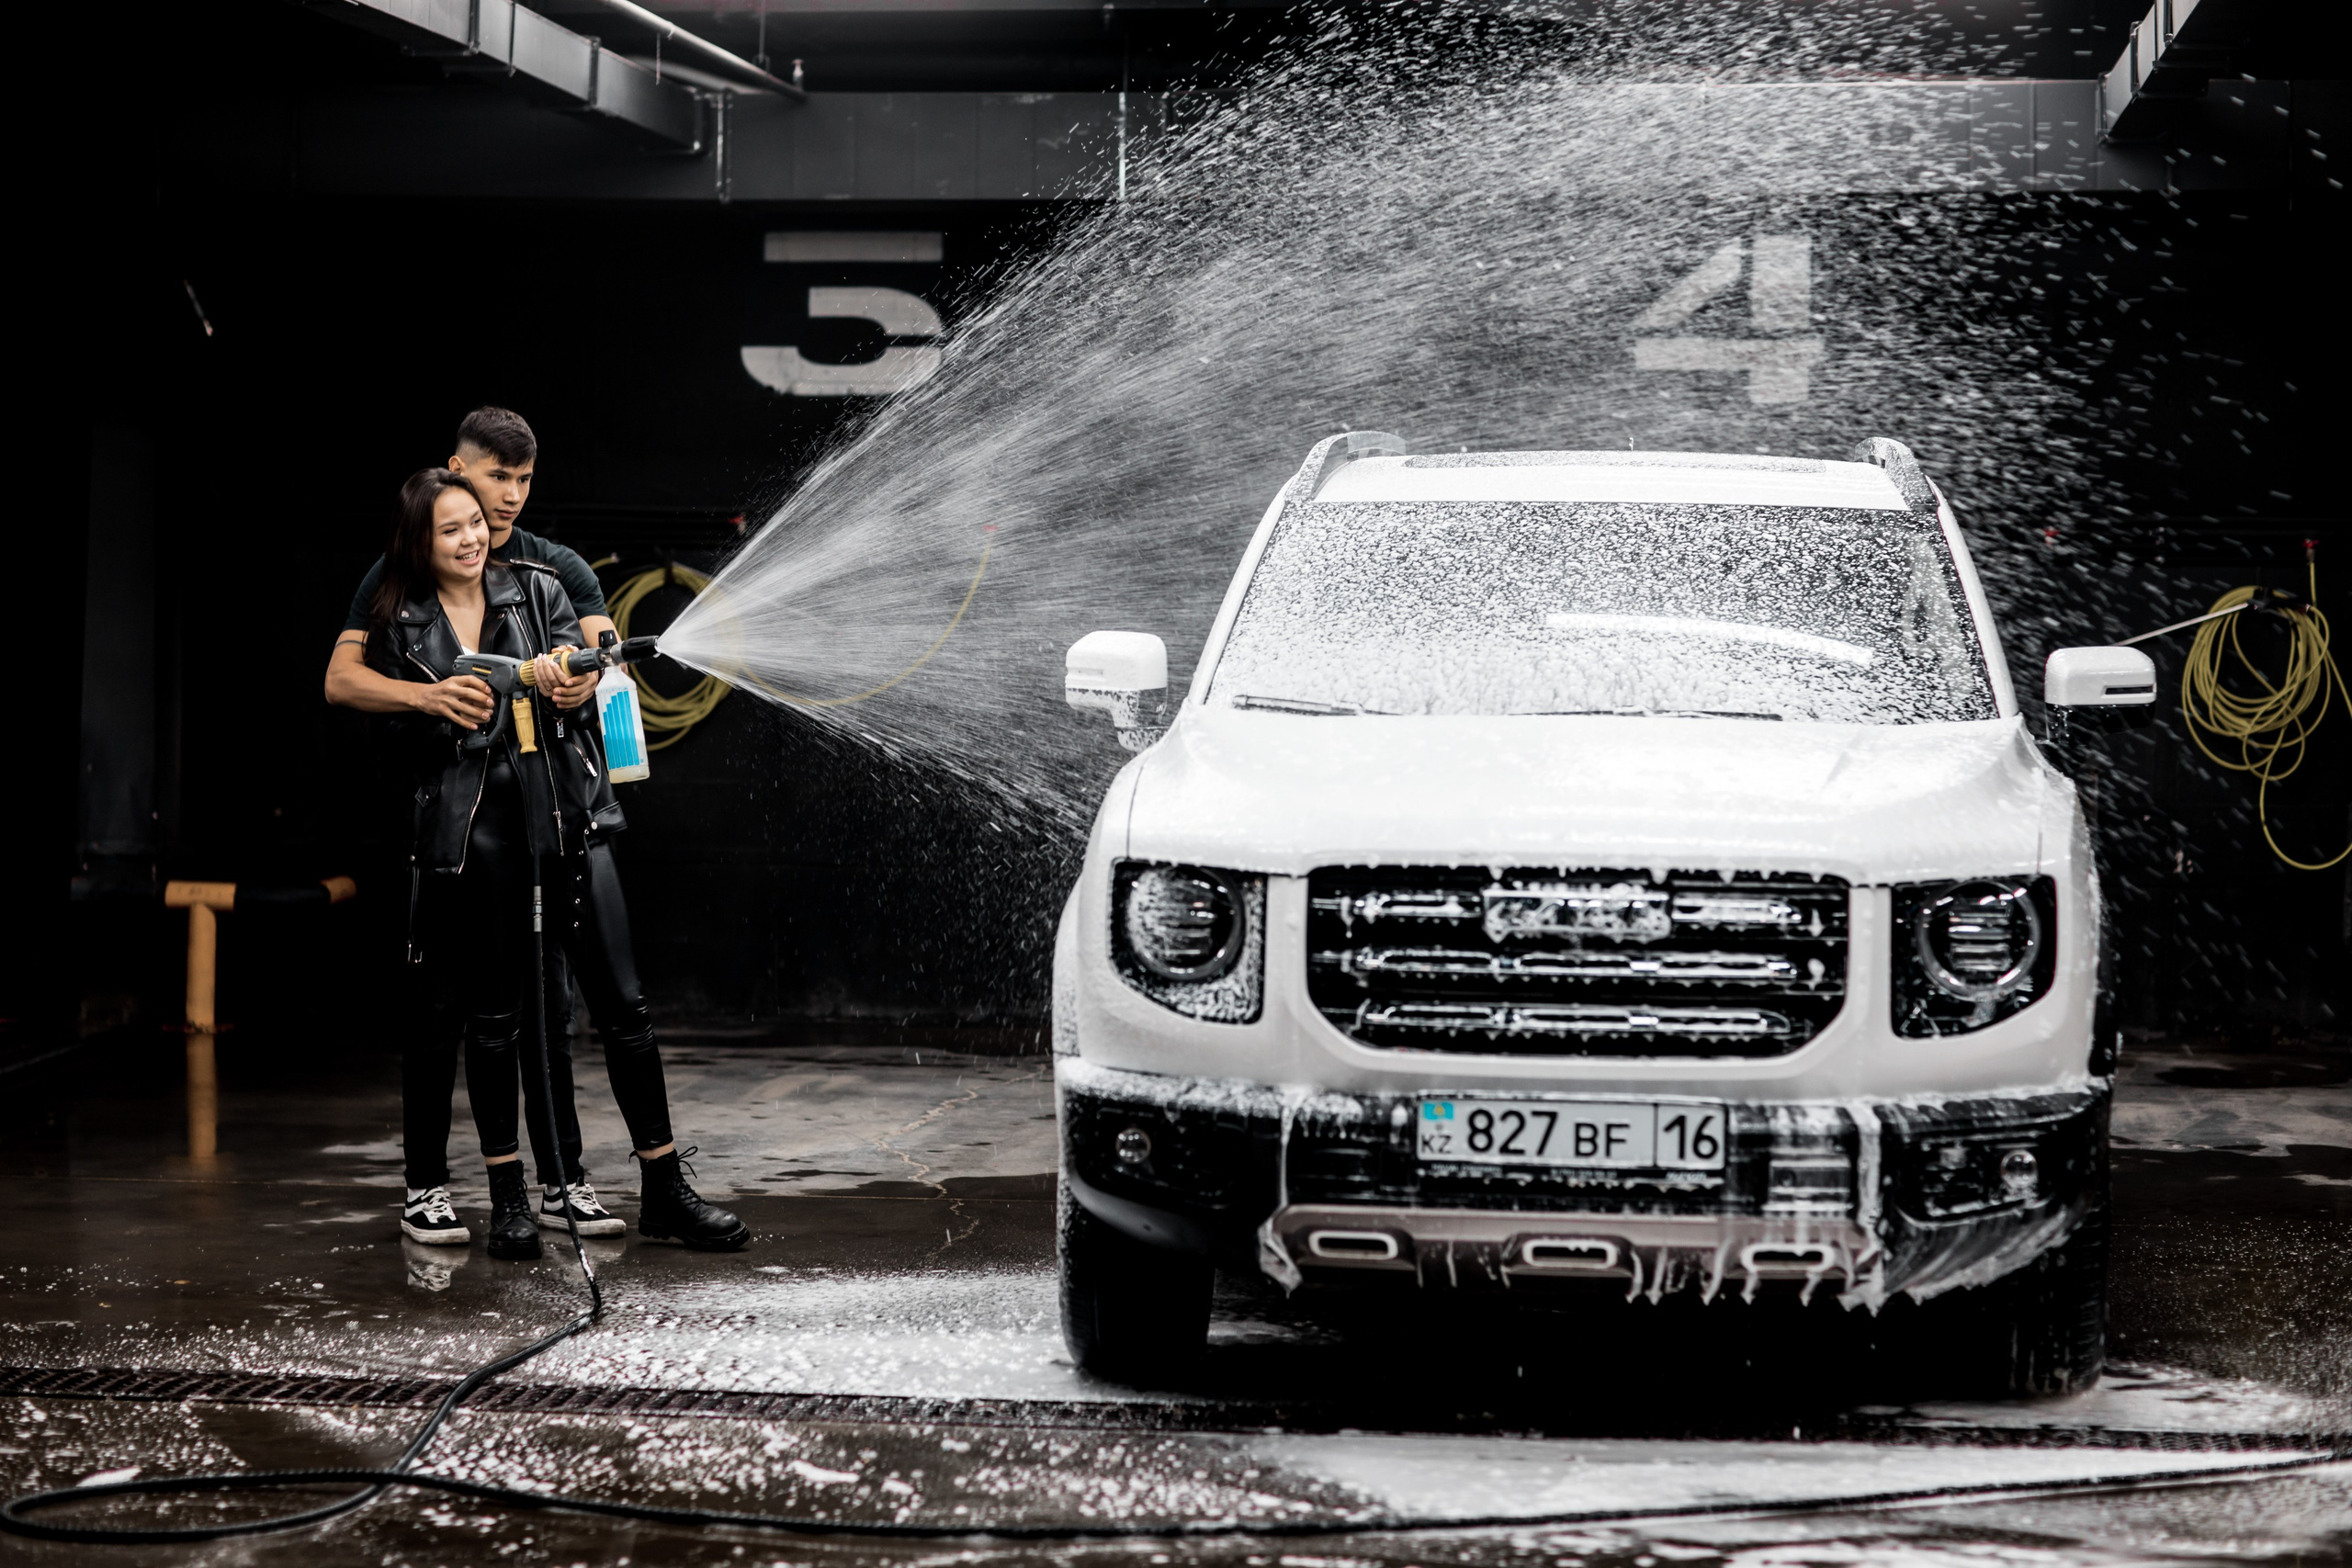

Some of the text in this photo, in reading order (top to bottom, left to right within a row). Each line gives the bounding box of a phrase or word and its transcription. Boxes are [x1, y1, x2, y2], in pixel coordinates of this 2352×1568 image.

[741, 231, 943, 396] 5
[1632, 236, 1825, 403] 4
[1421, 1134, 1452, 1154] KZ
[1467, 1109, 1719, 1160] 827 BF 16
